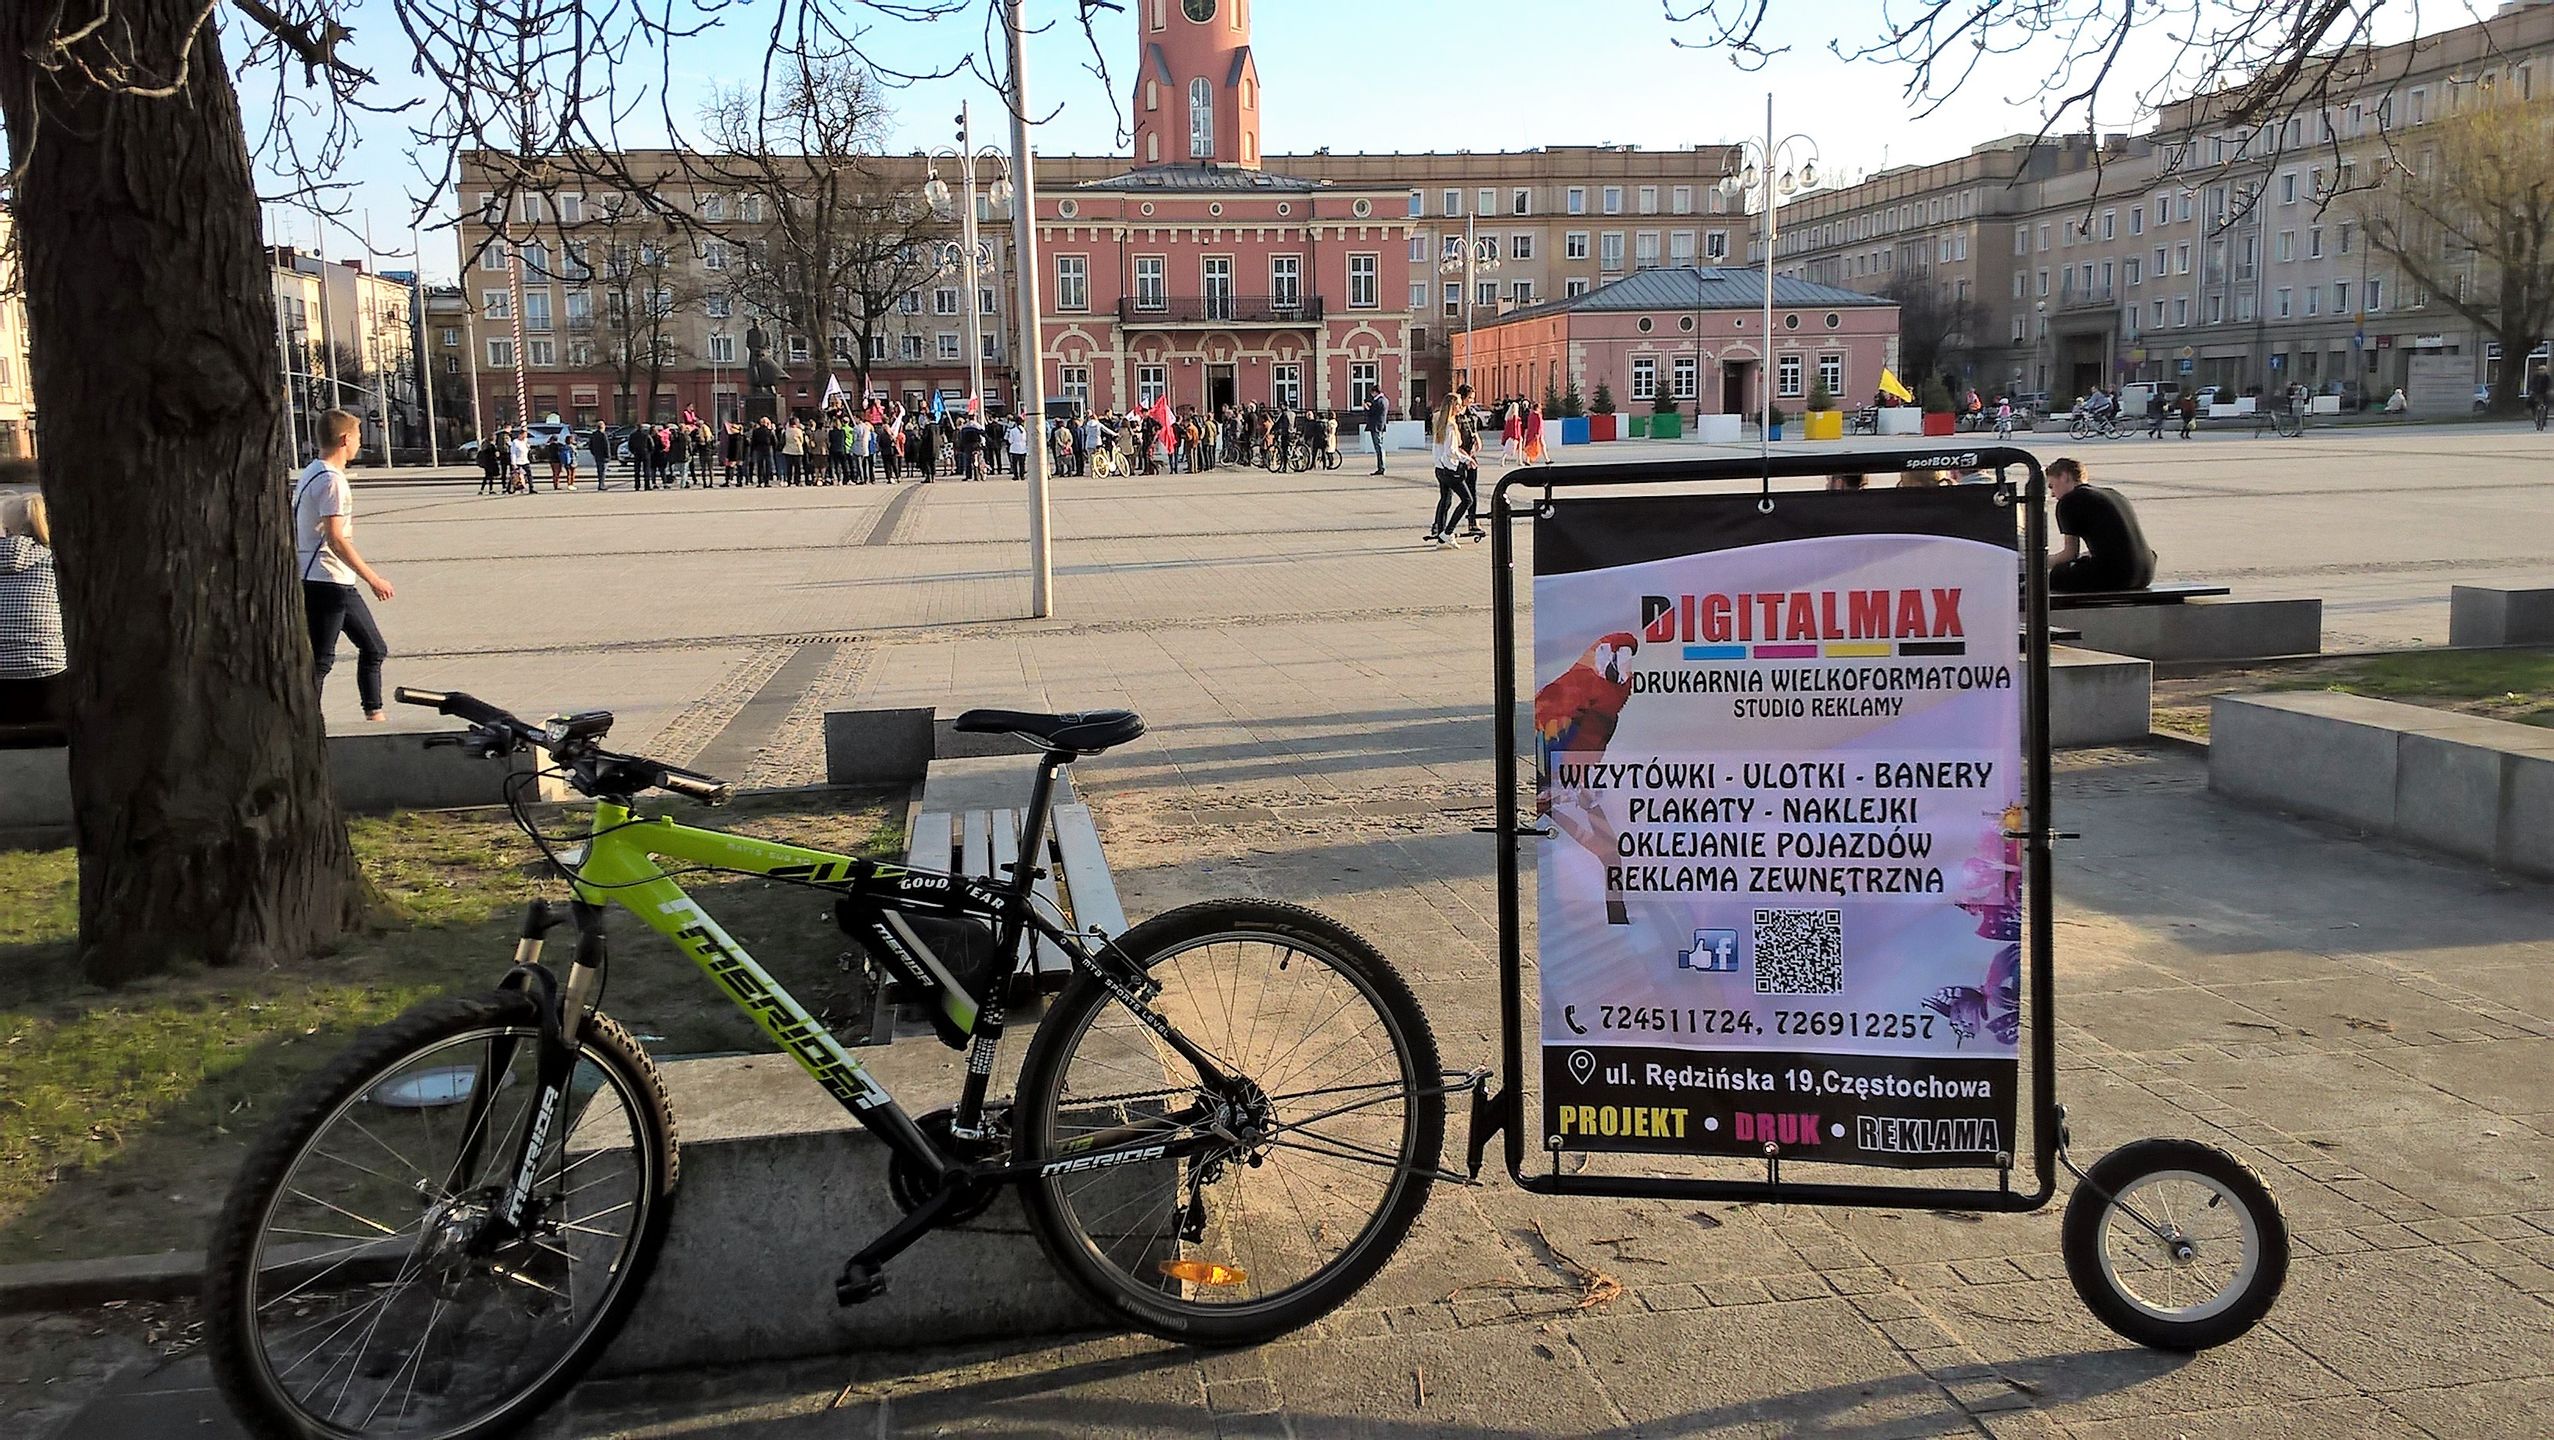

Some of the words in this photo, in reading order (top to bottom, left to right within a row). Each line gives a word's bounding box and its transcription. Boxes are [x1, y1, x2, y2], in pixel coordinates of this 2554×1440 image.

[1906, 455, 1960, 469] spotBOX
[1641, 587, 1965, 645] DIGITALMAX
[1633, 669, 1764, 694] DRUKARNIA
[1771, 665, 2011, 693] WIELKOFORMATOWA
[1733, 697, 1805, 718] STUDIO
[1811, 696, 1904, 717] REKLAMY
[1558, 756, 1715, 790] WIZYTÓWKI
[1743, 762, 1845, 790] ULOTKI
[1875, 762, 1993, 789] BANERY
[1629, 797, 1755, 823] PLAKATY
[1783, 797, 1918, 824] NAKLEJKI
[1616, 831, 1767, 859] OKLEJANIE
[1777, 828, 1932, 859] POJAZDÓW
[1606, 865, 1738, 893] REKLAMA
[1748, 866, 1944, 897] ZEWNĘTRZNA
[872, 923, 935, 988] MERIDA
[657, 897, 891, 1110] MERIDA
[1081, 957, 1103, 978] MTB
[1104, 978, 1142, 1012] SPORTS
[1141, 1010, 1170, 1038] LEVEL
[1600, 1005, 1763, 1036] 724511724,
[1774, 1010, 1935, 1040] 726912257
[1605, 1064, 1636, 1085] ul.
[1646, 1063, 1775, 1092] Rędzińska
[1559, 1105, 1689, 1138] PROJEKT
[1734, 1111, 1822, 1146] DRUK
[1857, 1114, 2001, 1154] REKLAMA
[506, 1085, 559, 1228] MERIDA
[1040, 1145, 1166, 1178] MERIDA
